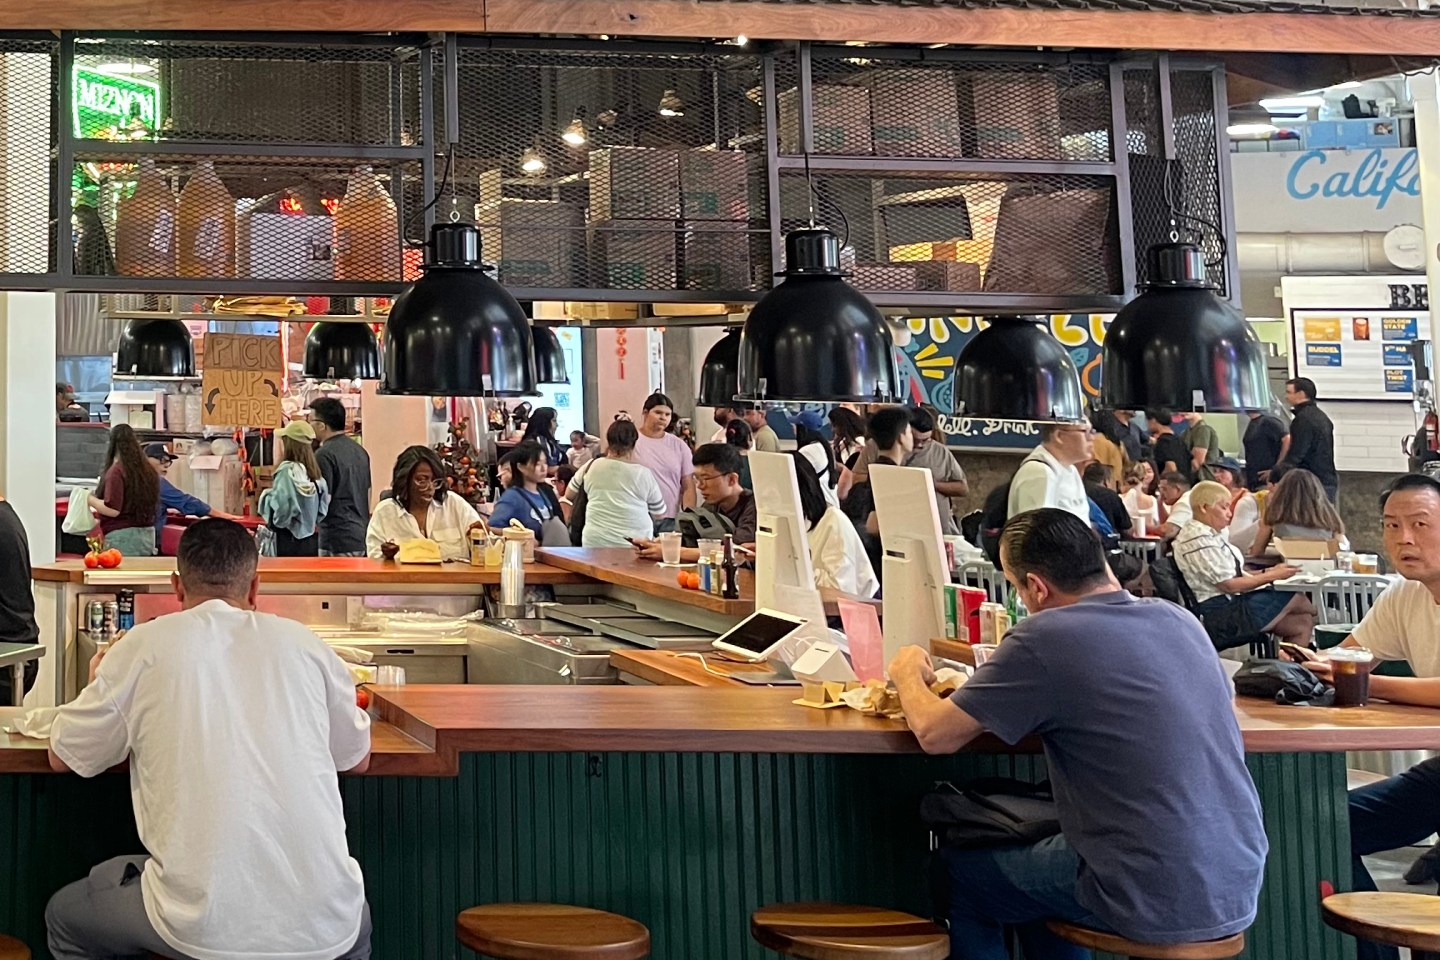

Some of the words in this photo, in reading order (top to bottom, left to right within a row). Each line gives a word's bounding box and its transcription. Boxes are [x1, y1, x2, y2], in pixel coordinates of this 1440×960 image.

[212, 337, 279, 369] PICK
[223, 370, 263, 397] UP
[220, 398, 277, 426] HERE
